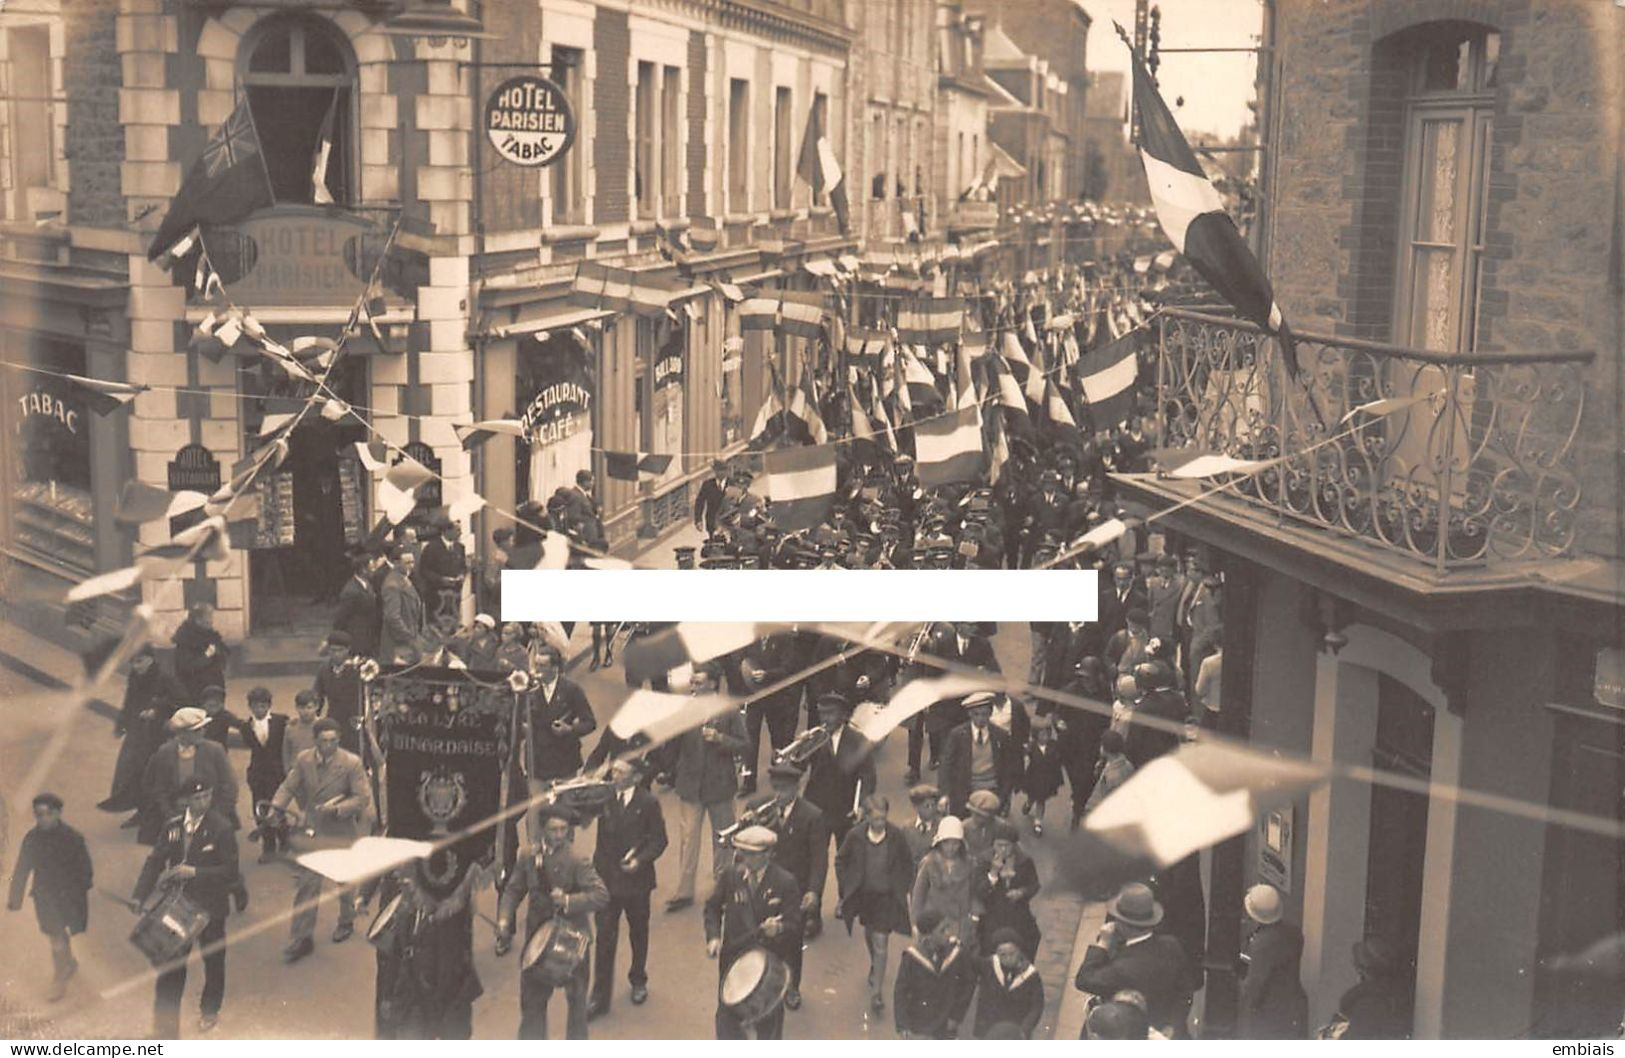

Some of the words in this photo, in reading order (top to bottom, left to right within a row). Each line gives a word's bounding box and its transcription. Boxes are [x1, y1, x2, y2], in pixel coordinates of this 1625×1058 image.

[498, 83, 555, 110] HOTEL
[490, 111, 565, 131] PARISIEN
[501, 133, 553, 159] TABAC
[260, 225, 340, 256] HOTEL
[256, 263, 345, 290] PARISIEN
[18, 392, 78, 434] TABAC
[520, 382, 591, 444] RESTAURANT
[540, 412, 574, 444] CAFÉ
